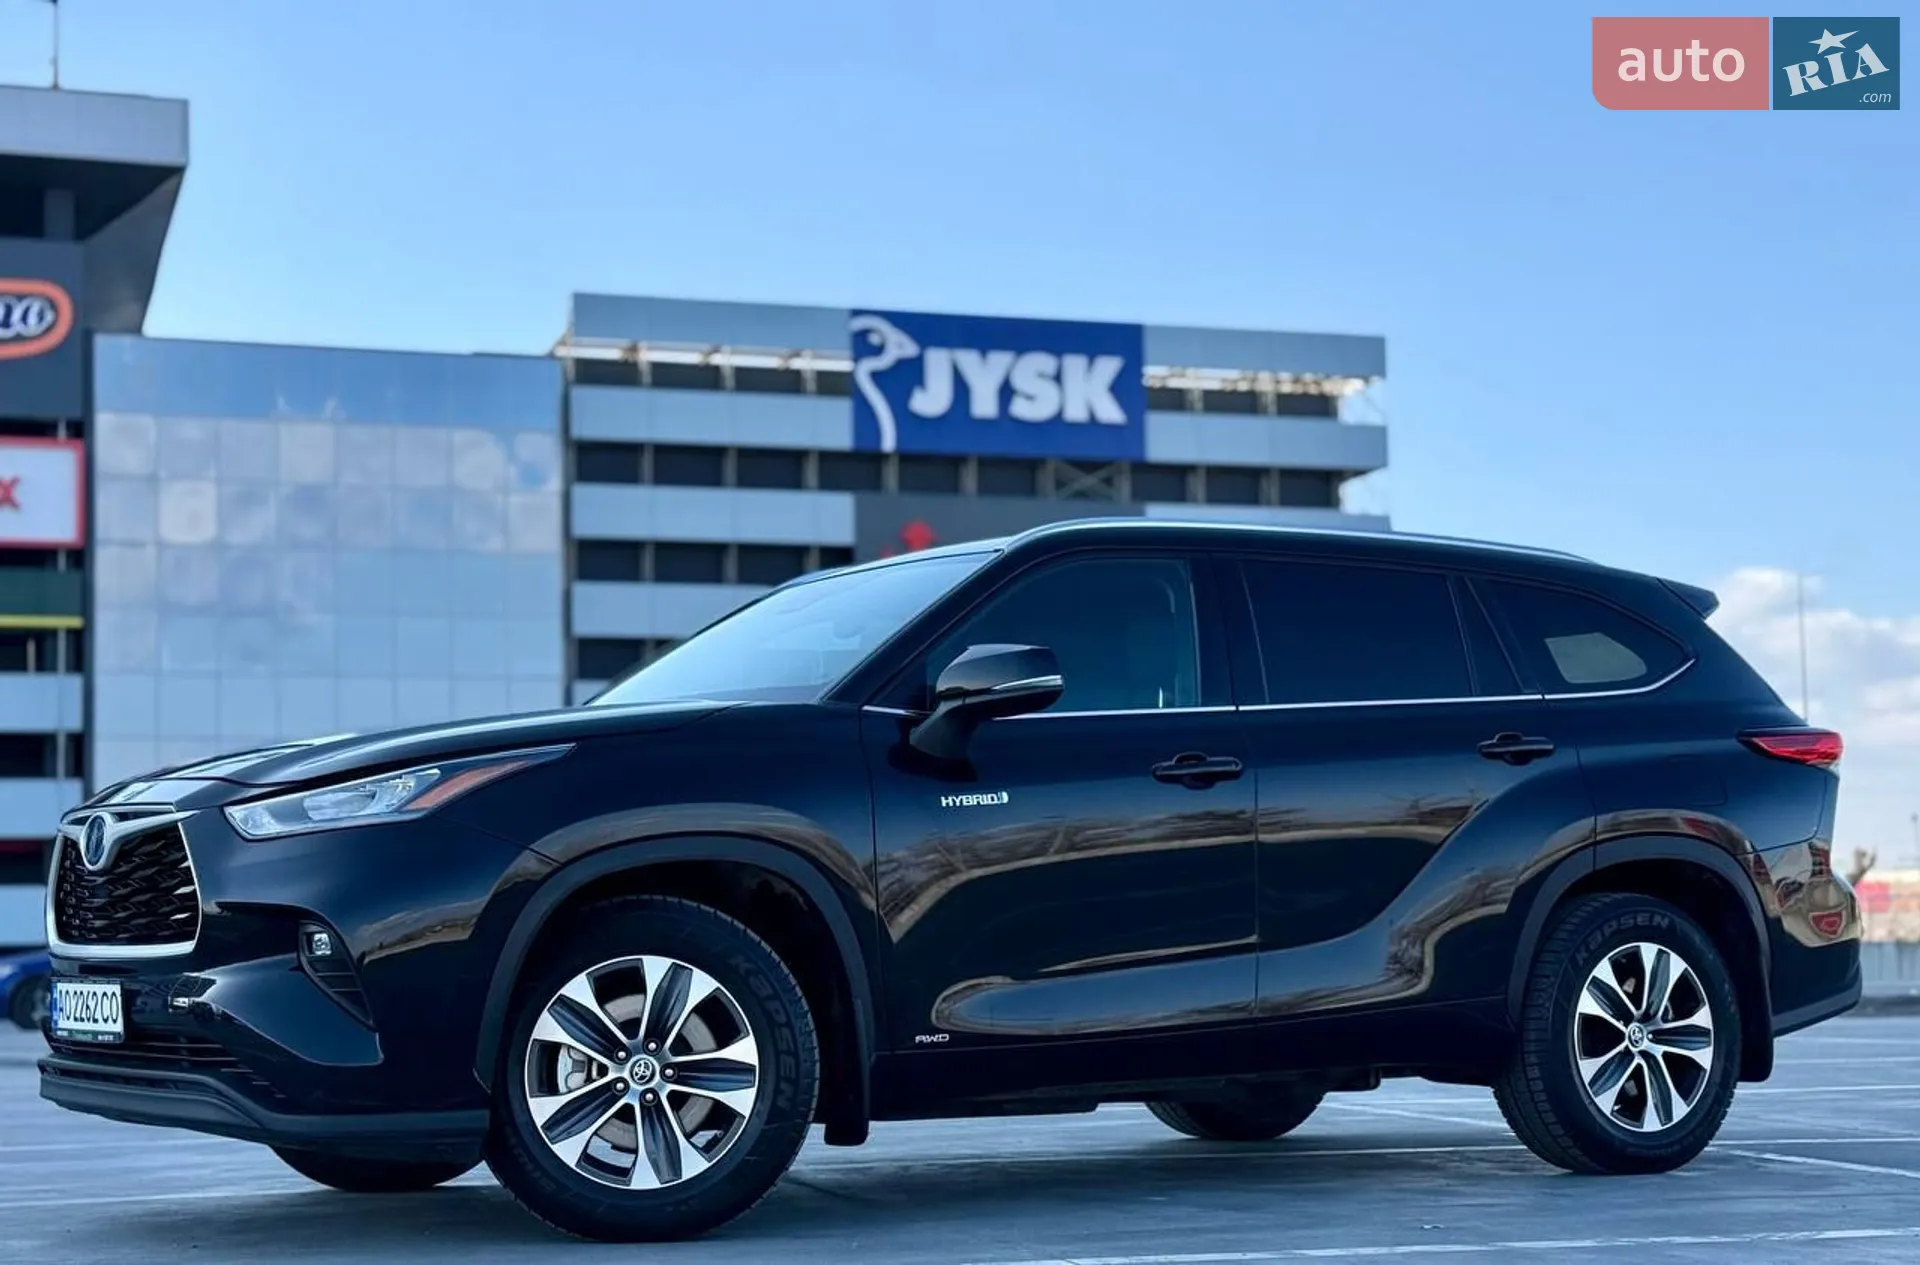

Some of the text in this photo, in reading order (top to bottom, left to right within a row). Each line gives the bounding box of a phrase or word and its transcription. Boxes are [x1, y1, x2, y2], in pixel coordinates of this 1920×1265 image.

[908, 347, 1127, 425] JYSK
[941, 792, 998, 807] HYBRID
[914, 1033, 949, 1044] AWD
